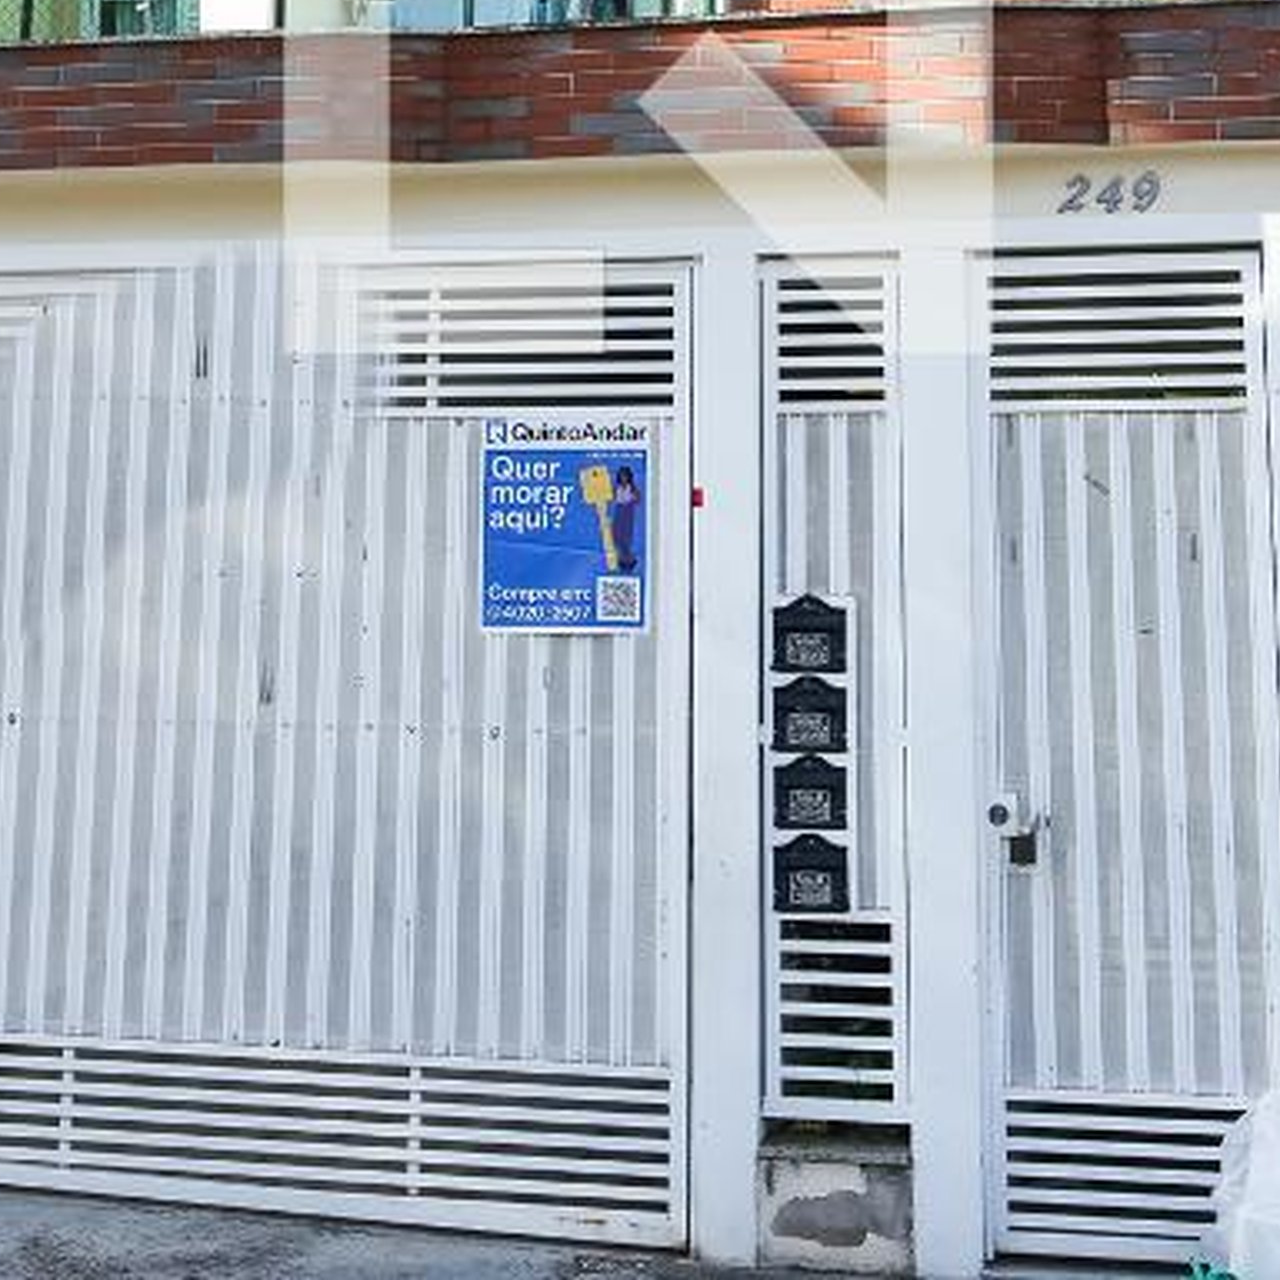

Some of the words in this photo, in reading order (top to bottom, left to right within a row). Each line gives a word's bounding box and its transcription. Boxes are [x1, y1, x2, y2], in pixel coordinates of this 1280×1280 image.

[1056, 170, 1161, 214] 249
[510, 422, 647, 443] QuintoAndar
[491, 456, 561, 481] Quer
[491, 484, 573, 504] morar
[489, 505, 565, 534] aqui?
